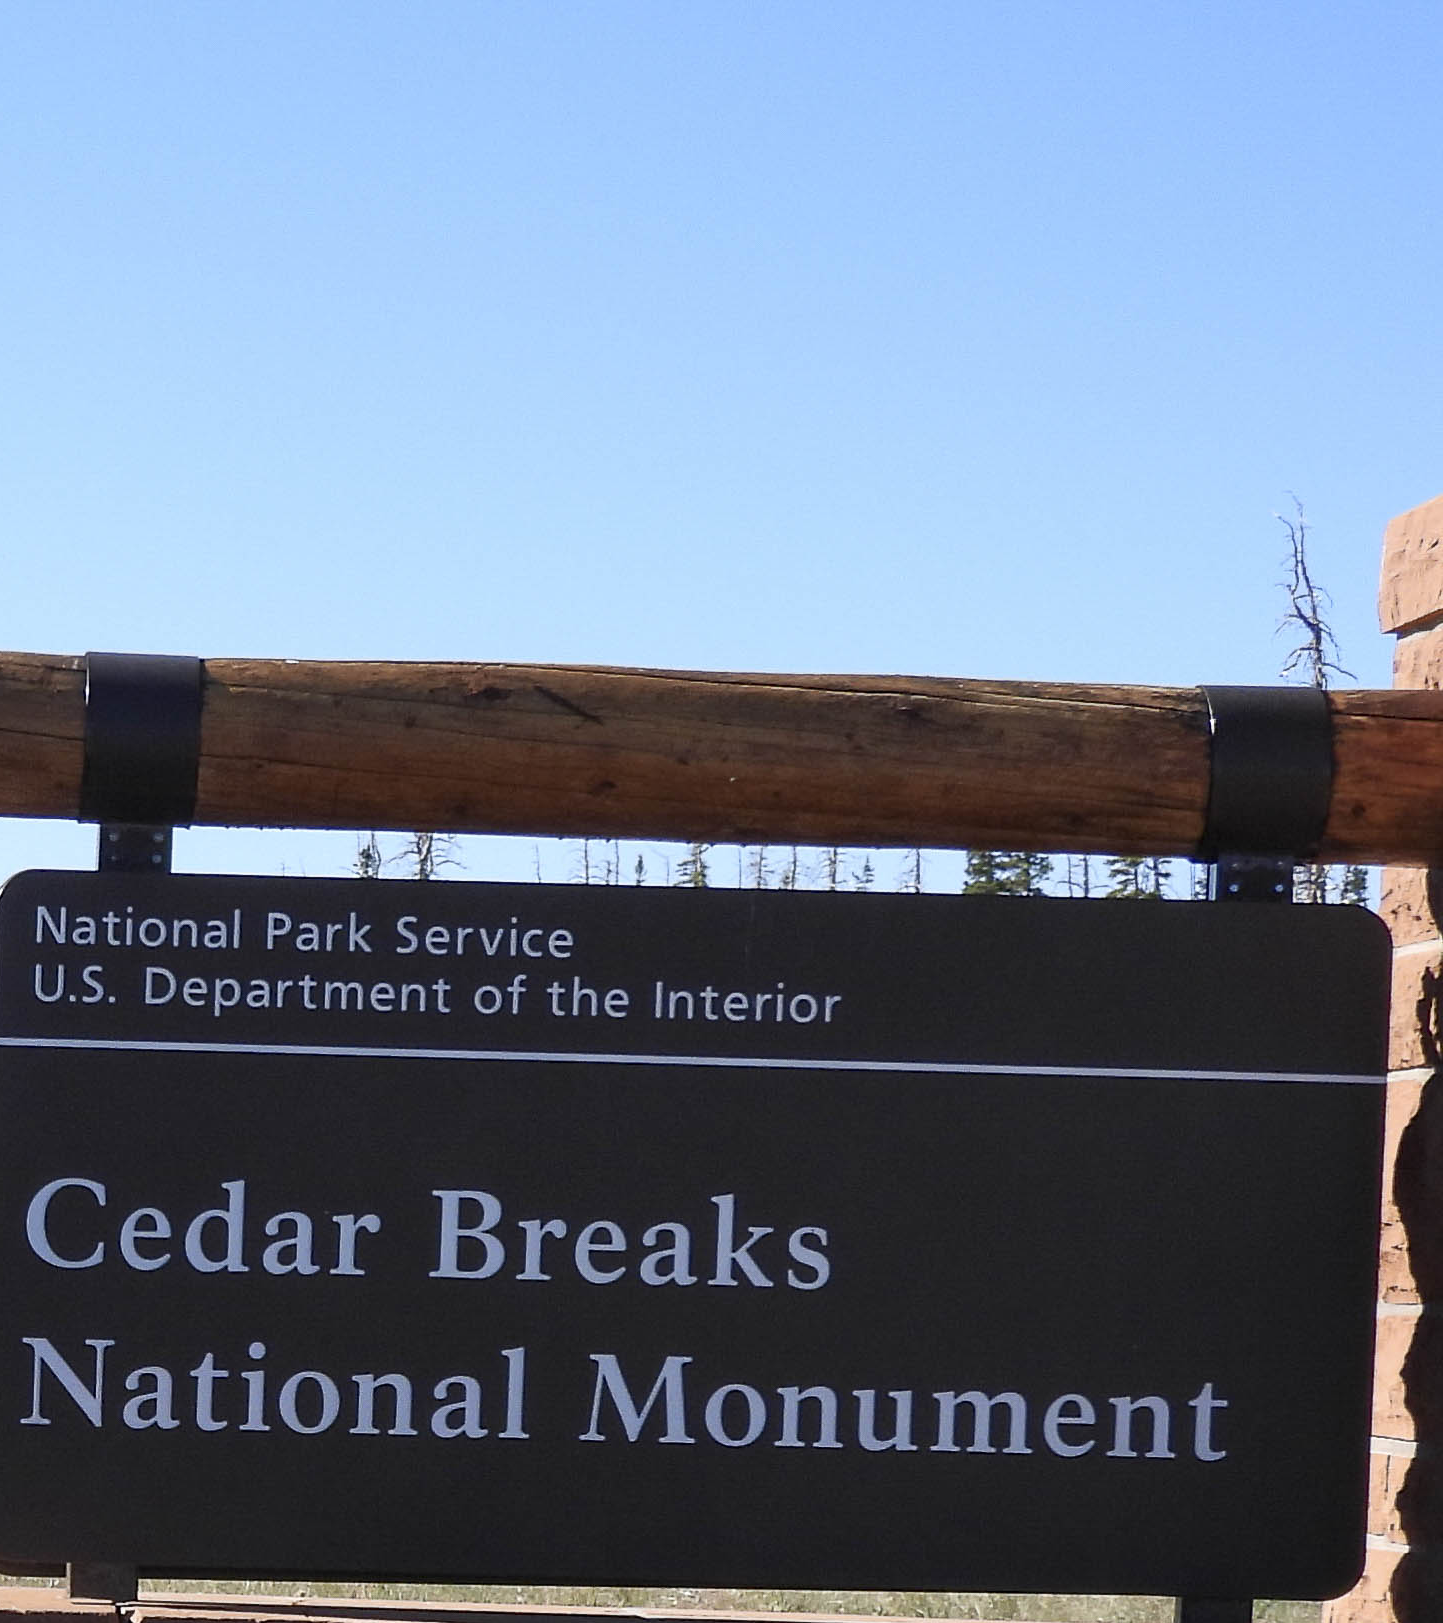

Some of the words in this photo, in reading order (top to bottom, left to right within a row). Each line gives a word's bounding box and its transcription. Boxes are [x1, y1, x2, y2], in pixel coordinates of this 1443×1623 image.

[35, 905, 242, 950] National
[265, 911, 373, 954] Park
[395, 915, 575, 959] Service
[33, 962, 118, 1004] U.S.
[143, 965, 452, 1018] Department
[473, 973, 528, 1016] of
[545, 974, 631, 1019] the
[654, 980, 843, 1024] Interior
[25, 1176, 382, 1276] Cedar
[427, 1188, 831, 1291] Breaks
[18, 1336, 531, 1440] National
[577, 1352, 1229, 1462] Monument
